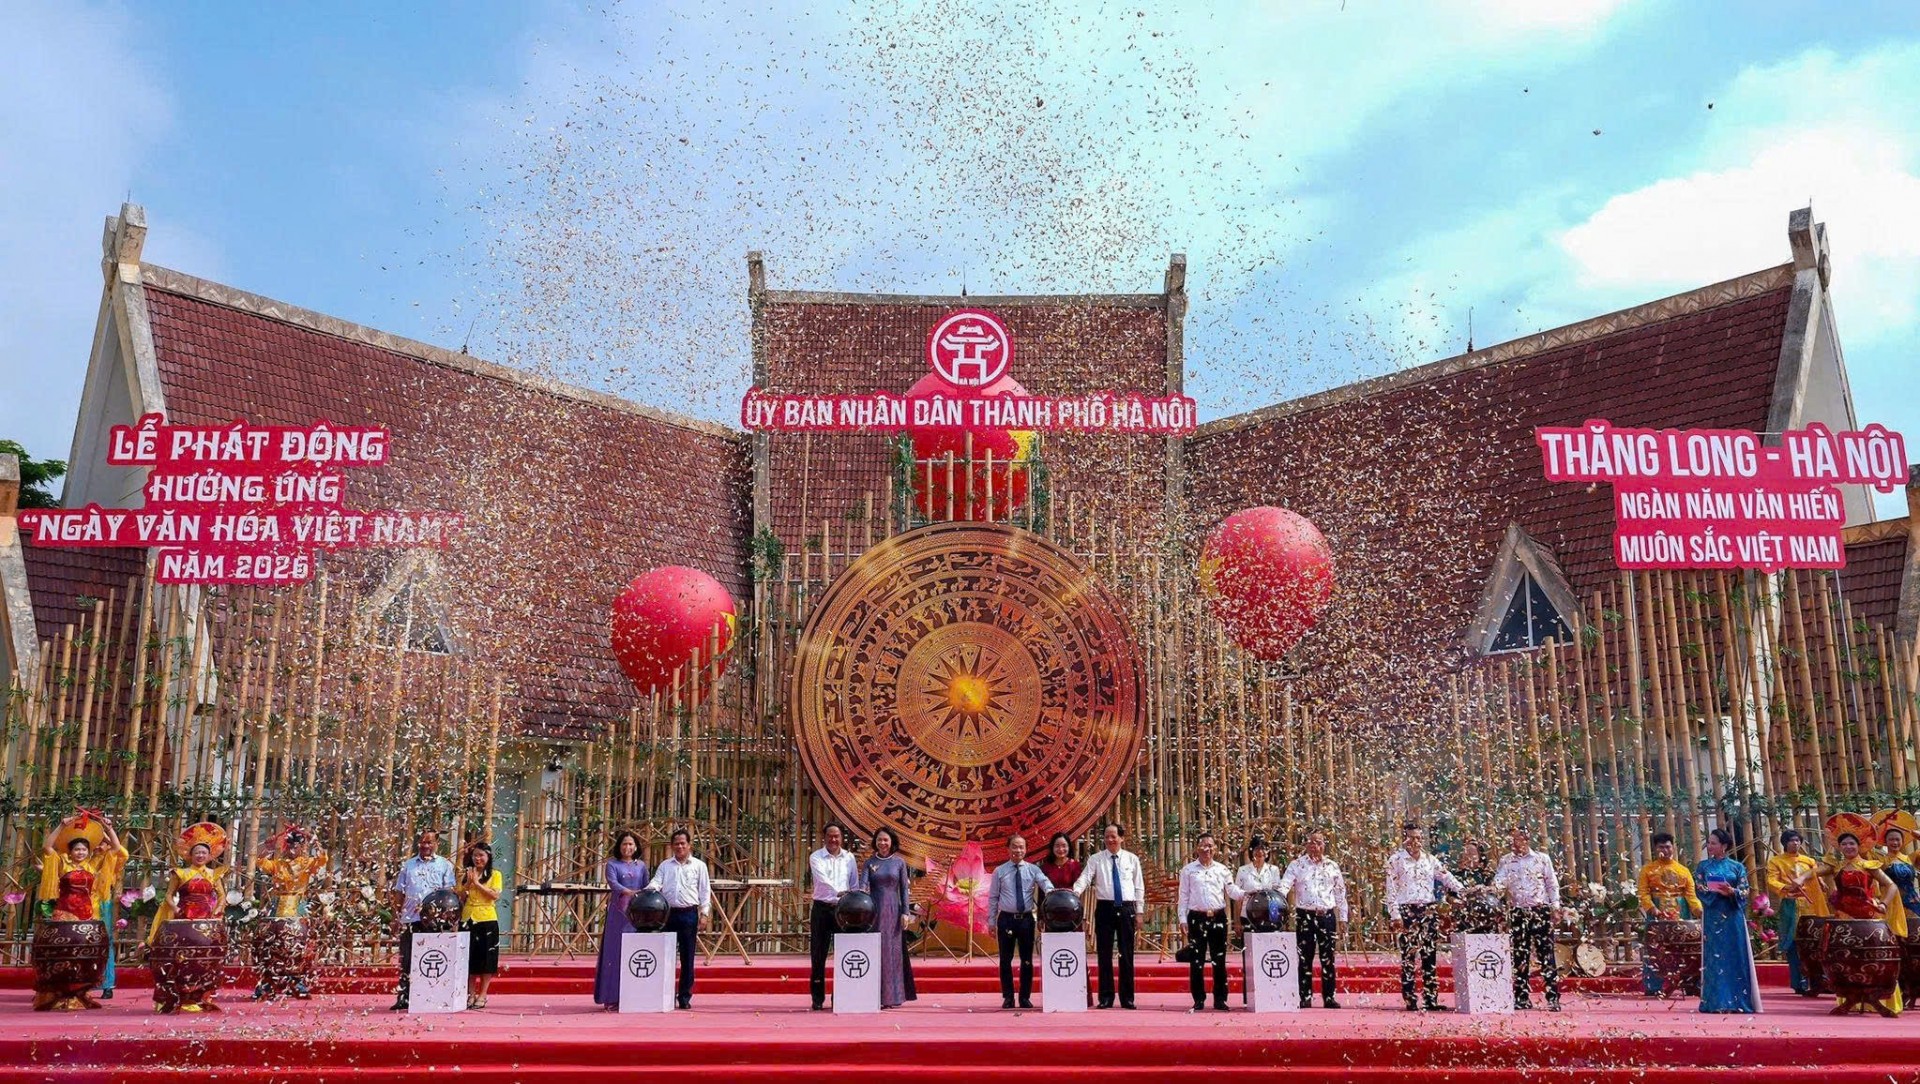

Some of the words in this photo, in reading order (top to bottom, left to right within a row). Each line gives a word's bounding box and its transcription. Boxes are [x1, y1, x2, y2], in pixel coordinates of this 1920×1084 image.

[747, 391, 777, 426] ỦY
[784, 400, 832, 426] BAN
[840, 395, 906, 426] NHÂN
[914, 395, 962, 425] DÂN
[970, 396, 1049, 426] THÀNH
[1059, 394, 1109, 427] PHỐ
[1112, 397, 1145, 428] HÀ
[1152, 398, 1191, 432] NỘI
[112, 419, 158, 460] LỄ
[170, 424, 269, 461] PHÁT
[280, 426, 384, 468] ĐỘNG
[1541, 426, 1660, 476] THĂNG
[1667, 435, 1758, 477] LONG
[1789, 429, 1839, 478] HÀ
[1844, 430, 1903, 487] NỘI
[149, 468, 264, 502] HƯỞNG
[275, 470, 339, 501] ỨNG
[1620, 488, 1681, 519] NGÀN
[1685, 488, 1736, 519] NĂM
[1739, 488, 1785, 519] VĂN
[1789, 486, 1840, 520] HIẾN
[136, 509, 200, 541] VĂN
[209, 510, 280, 542] HÓA
[293, 510, 363, 547] VIỆT
[1620, 530, 1685, 562] MUÔN
[1690, 525, 1733, 562] SẮC
[1736, 531, 1783, 567] VIỆT
[1789, 536, 1840, 562] NAM
[162, 550, 224, 579] NĂM
[235, 555, 308, 579] 2026
